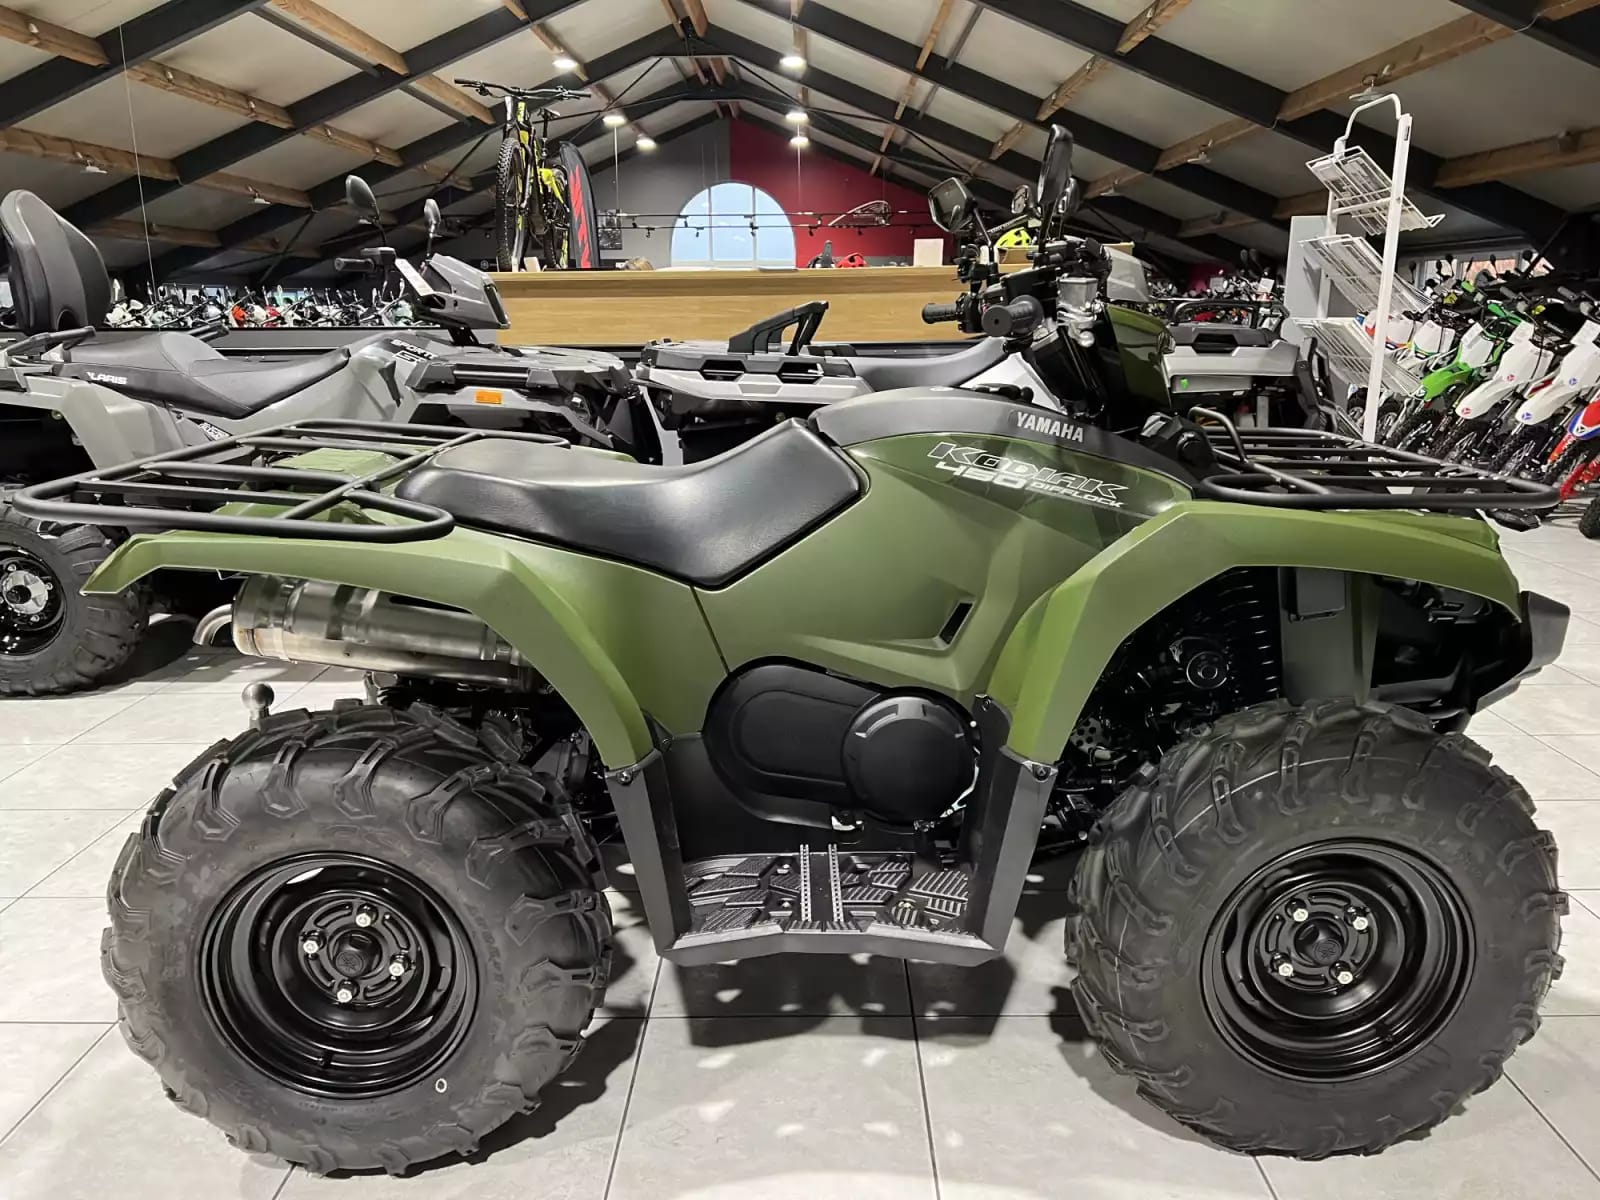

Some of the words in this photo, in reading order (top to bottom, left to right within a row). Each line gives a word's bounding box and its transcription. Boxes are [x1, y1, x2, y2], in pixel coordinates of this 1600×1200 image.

[1016, 411, 1084, 443] YAMAHA
[927, 441, 1129, 500] KODIAK
[935, 461, 1027, 490] 450
